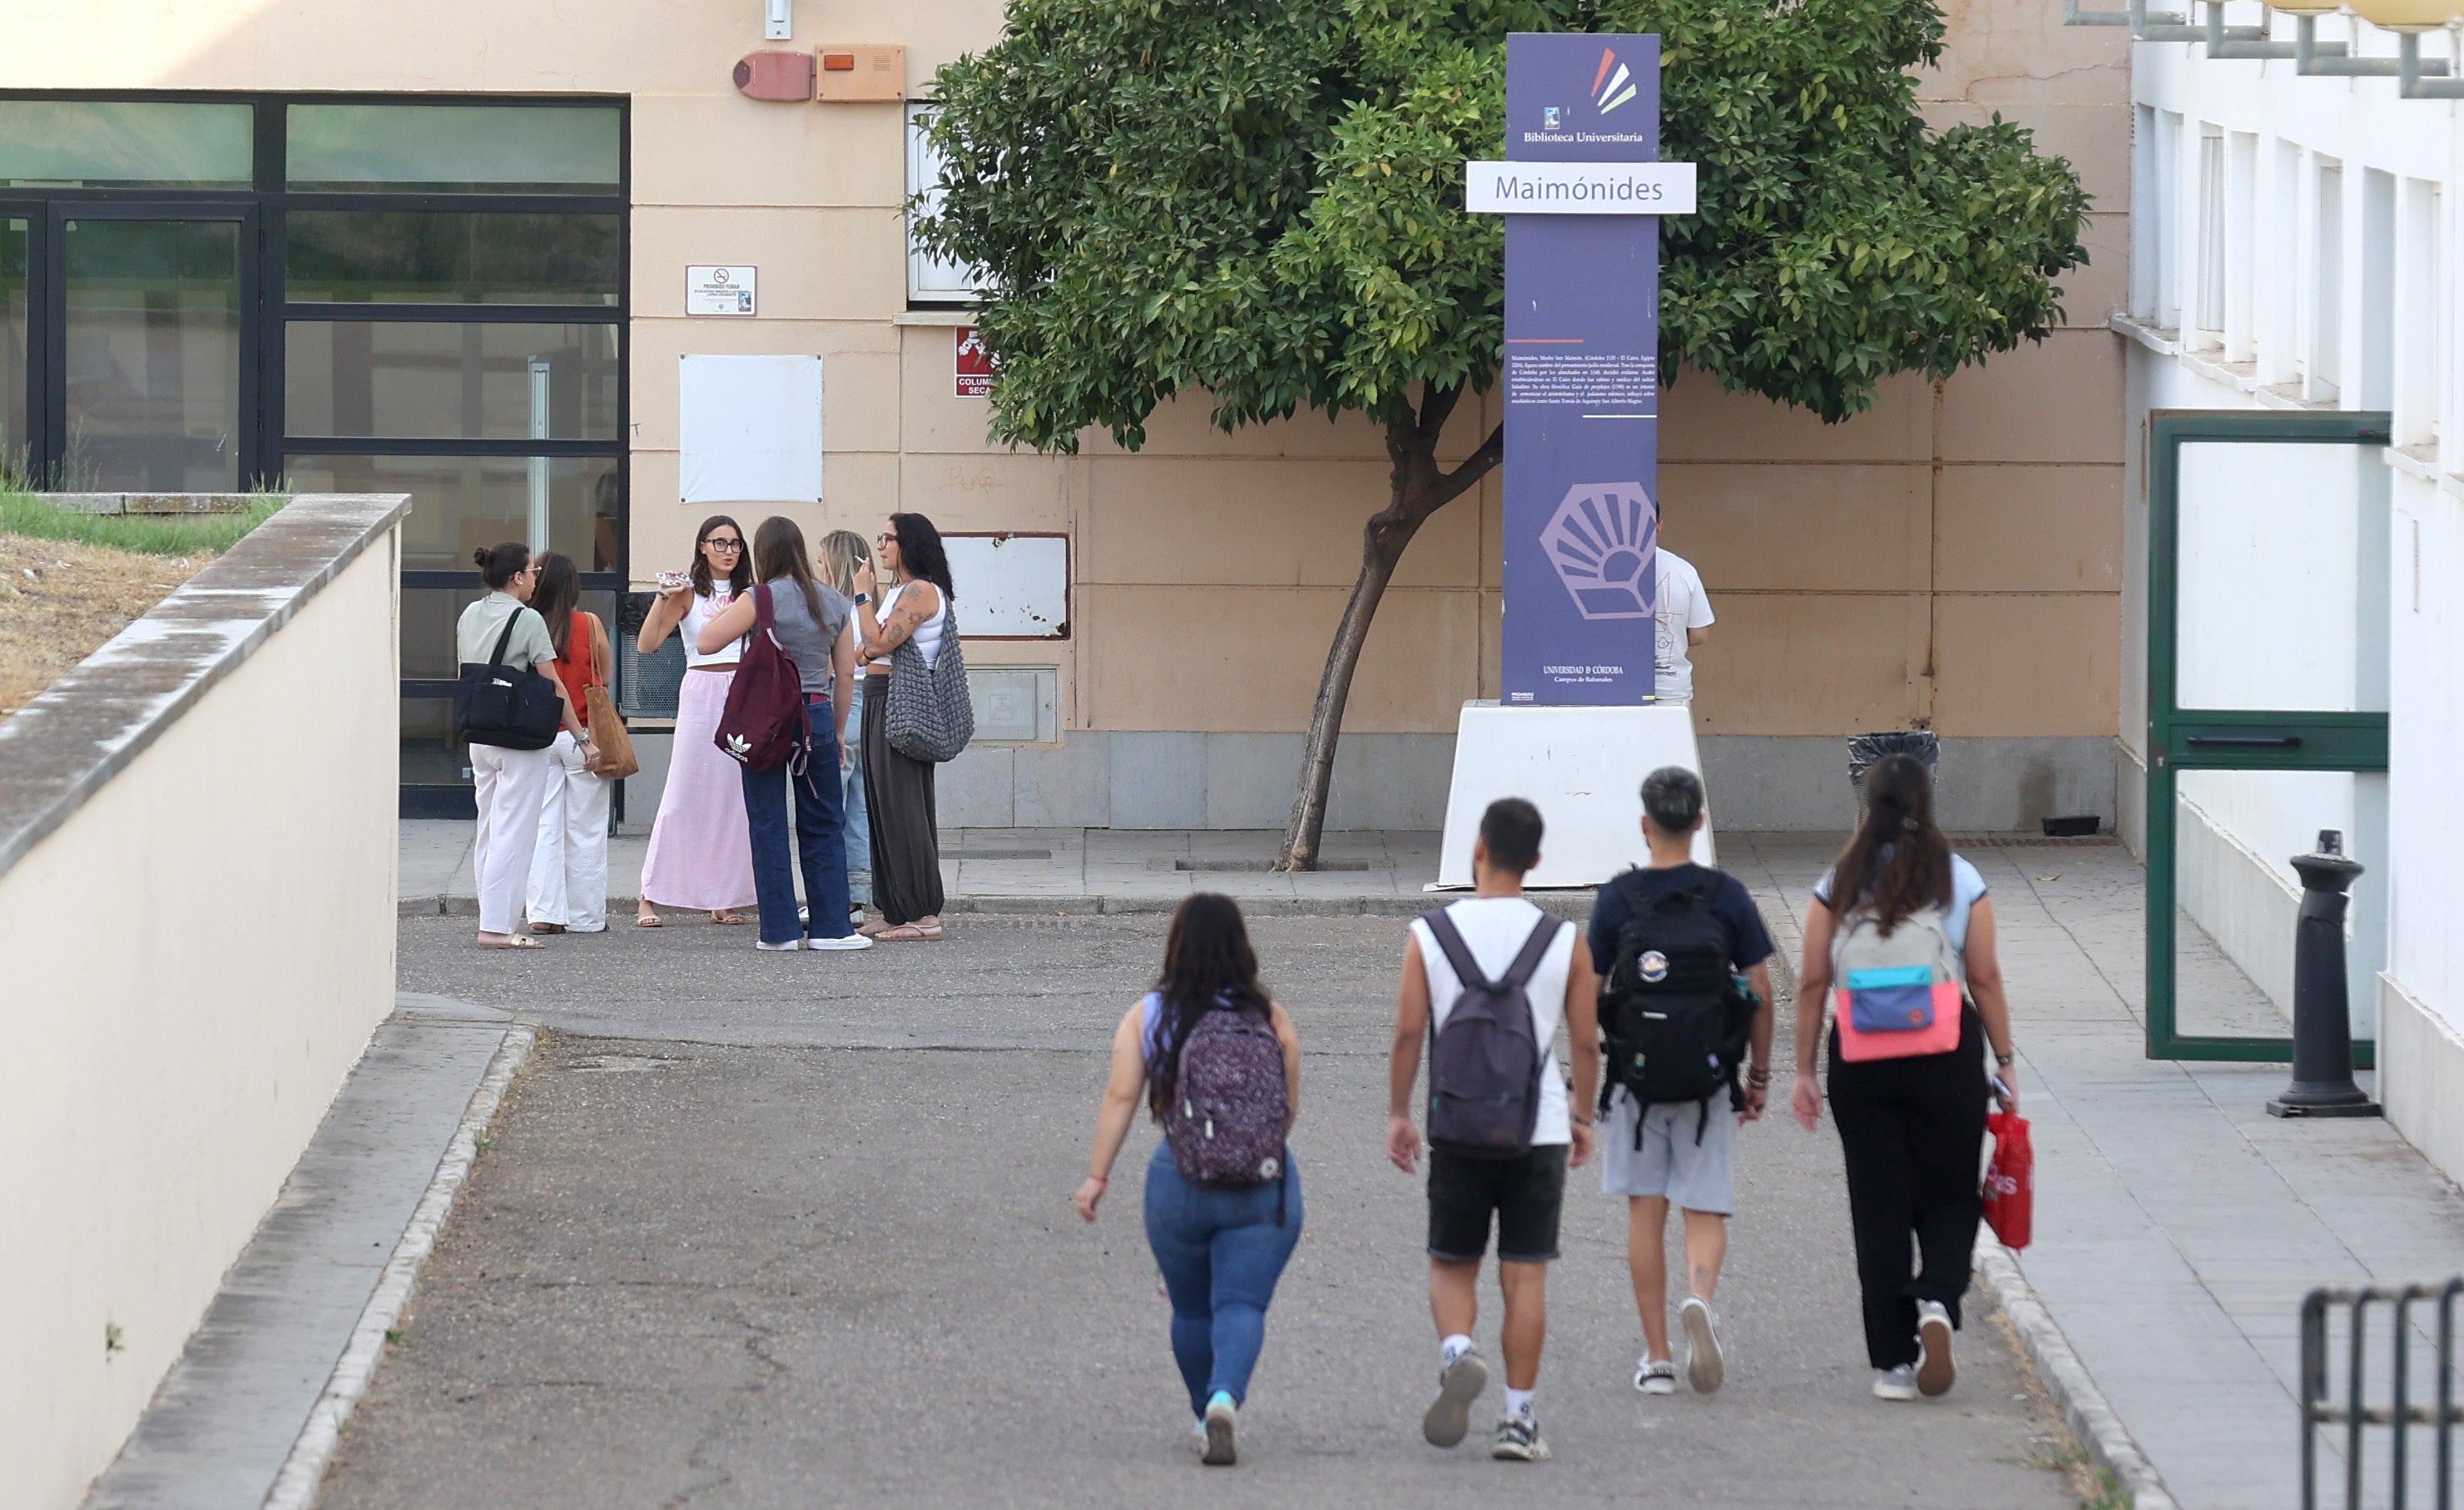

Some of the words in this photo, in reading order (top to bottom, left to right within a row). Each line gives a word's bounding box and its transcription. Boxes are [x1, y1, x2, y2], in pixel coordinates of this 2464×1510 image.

[1525, 132, 1574, 142] Biblioteca
[1577, 132, 1643, 142] Universitaria
[1495, 176, 1663, 201] Maimónides
[1543, 665, 1584, 674] UNIVERSIDAD
[1593, 663, 1624, 674] CÓRDOBA
